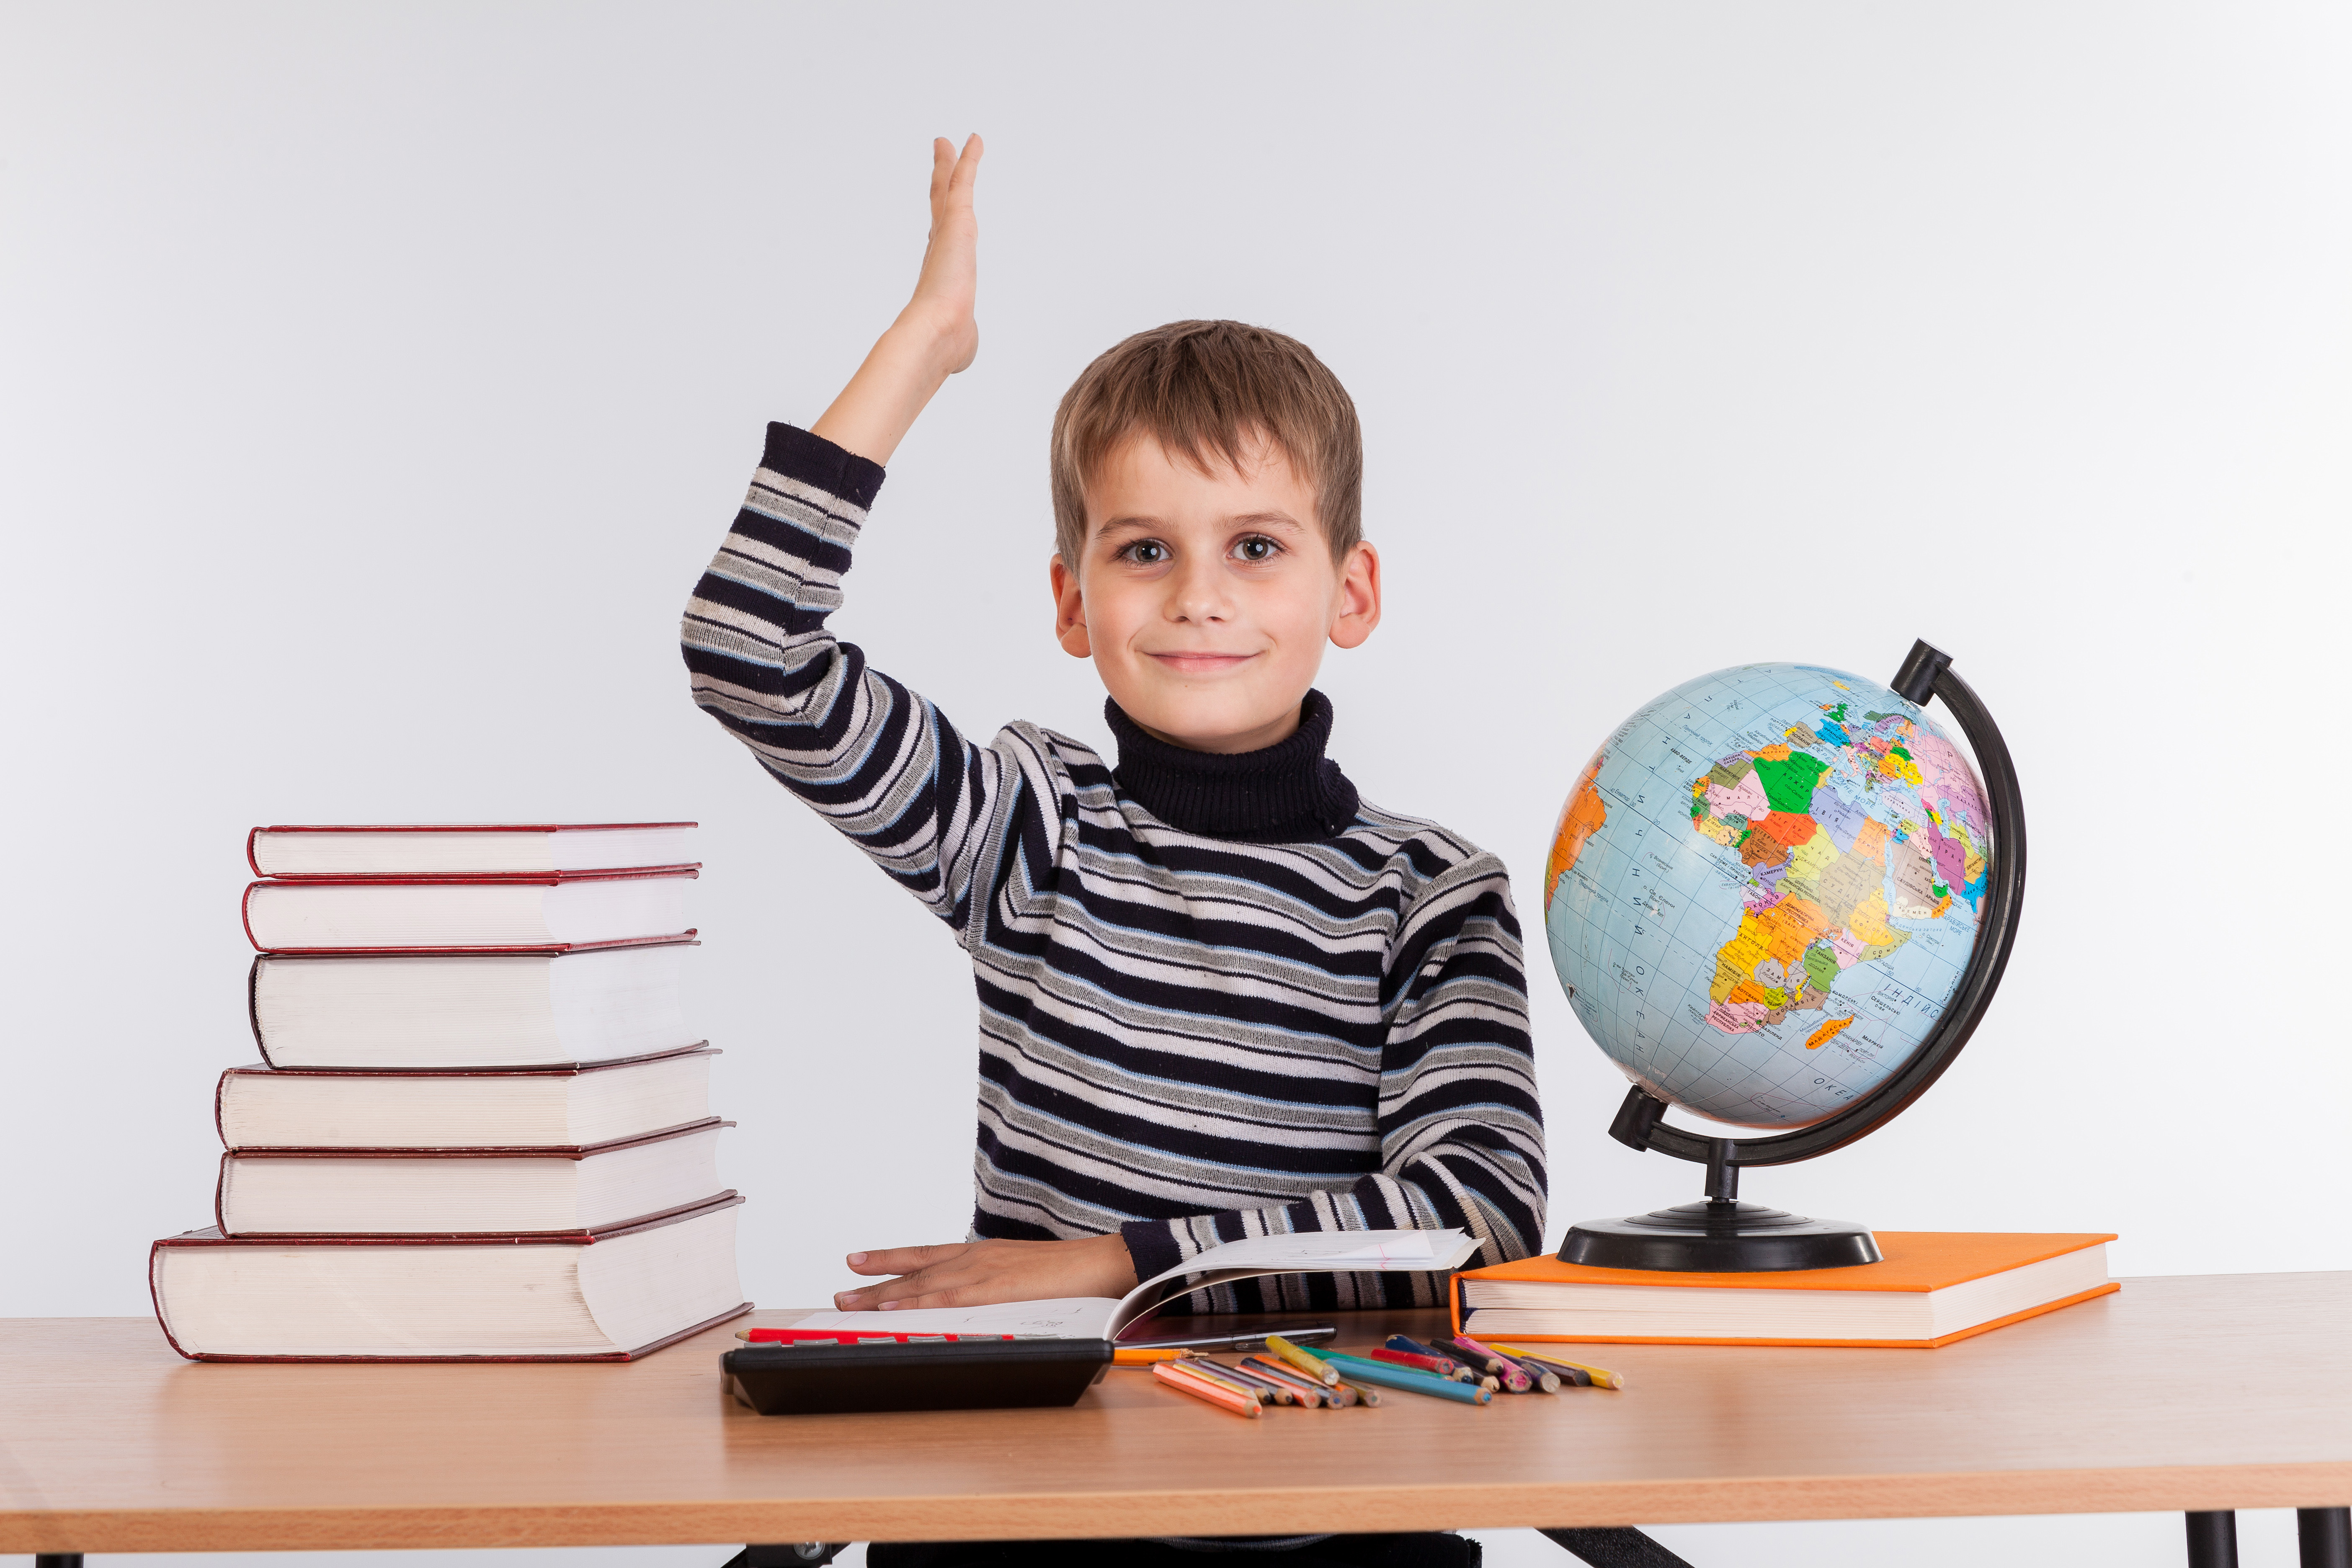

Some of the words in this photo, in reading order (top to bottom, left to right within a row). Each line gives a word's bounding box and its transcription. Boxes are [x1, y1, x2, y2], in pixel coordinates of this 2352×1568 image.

[1682, 725, 1700, 738] Північний
[1700, 736, 1713, 746] тропік
[1754, 730, 1775, 745] Касабланка
[1792, 732, 1811, 746] ІСПАНІЯ
[1797, 727, 1814, 739] МАДРИД
[1824, 727, 1842, 740] ФРАНЦІЯ
[1670, 748, 1692, 764] КАБО-ВЕРДЕ
[1720, 766, 1741, 780] МАВРИТАНІЯ
[1757, 760, 1771, 771] Тіндуф
[1714, 769, 1729, 779] НУАКШОТ
[1783, 772, 1810, 793] АЛЖИР
[1829, 777, 1843, 787] Сфакс
[1614, 788, 1630, 802] Екватор
[1738, 785, 1753, 795] Араван
[1787, 785, 1805, 800] Ін-Салах
[1632, 670, 1771, 935] АТЛАНТИЧНИЙ
[1695, 798, 1708, 807] ГВІНЕЯ
[1711, 801, 1725, 812] БАМАКО
[1767, 793, 1794, 812] Таманрассет
[1854, 795, 1876, 810] МОРЕ
[1884, 795, 1910, 814] ТУРЕЧЧИНА
[1733, 809, 1748, 821] БУРКІНА
[1733, 815, 1744, 824] -ФАСО
[1808, 803, 1839, 823] ЛІВІЯ
[1837, 809, 1851, 820] Уаддан
[1772, 812, 1802, 832] НІГЕР
[1738, 831, 1749, 846] БЕНІН
[1754, 827, 1776, 844] НІГЕРІЯ
[1754, 842, 1768, 855] АБУДЖА
[1810, 846, 1830, 861] ЧАД
[1858, 838, 1884, 856] ЄГИПЕТ
[1654, 855, 1674, 870] Вознесіння
[1710, 853, 1728, 867] САН-ТОМЕ
[1939, 846, 1962, 864] ІРАН
[1656, 862, 1669, 873] (Брит.)
[1797, 855, 1822, 872] НДЖАМЕНА
[1715, 869, 1730, 881] затока
[1761, 868, 1783, 877] КАМЕРУН
[1762, 878, 1776, 887] ЯУНДЕ
[1578, 879, 1596, 895] Південний
[1596, 892, 1609, 904] тропік
[1747, 890, 1761, 901] ГАБОН
[1823, 878, 1858, 904] СУДАН
[1897, 877, 1923, 895] САУДІВСЬКА
[1925, 894, 1940, 906] АРАВІЯ
[1658, 895, 1675, 909] Єлени
[1753, 895, 1779, 908] КОНГО
[1786, 903, 1815, 922] ДЕМОКРАТИЧНА
[1786, 907, 1809, 924] РЕСПУБЛІКА
[1854, 919, 1889, 939] ЕФІОПІЯ
[1896, 922, 1922, 931] Аденська
[1943, 914, 1970, 933] АРАВІЙСЬКЕ
[1949, 926, 1962, 936] МОРЕ
[1739, 933, 1763, 951] АНГОЛА
[1841, 937, 1854, 948] КЕНІЯ
[1872, 933, 1907, 956] СОМАЛІ
[1926, 934, 1940, 945] Сокотра
[1815, 949, 1836, 965] ТАНЗАНІЯ
[1621, 966, 1635, 978] Трістан
[1722, 963, 1741, 977] НАМІБІЯ
[1766, 968, 1800, 983] ЗАМБІЯ
[1808, 963, 1825, 974] ДОДАМА
[1761, 971, 1776, 983] ЛУСАКА
[1737, 986, 1759, 1003] БОТСВАНА
[1832, 989, 1859, 1005] КОМОРСЬКІ
[1877, 991, 1895, 1002] ВІКТОРІЯ
[1635, 966, 1645, 1053] ОКЕАН
[1775, 997, 1816, 1017] МОЗАМБІК
[1871, 995, 1901, 1016] СЕЙШЕЛЬСЬКІ
[1884, 983, 1944, 1022] ІНДІЙСЬ
[1712, 1011, 1739, 1029] -АФРИКАНСЬКА
[1712, 1015, 1735, 1032] РЕСПУБЛІКА
[1800, 1014, 1829, 1033] Мозамбікська
[1747, 1024, 1765, 1037] ЛЕСОТО
[1759, 1024, 1783, 1040] СВАЗІЛЕНД
[1805, 1022, 1823, 1034] протока
[1808, 1020, 1853, 1047] МАДАГАСКАР
[1862, 1034, 1884, 1050] МАВРИКІЙ
